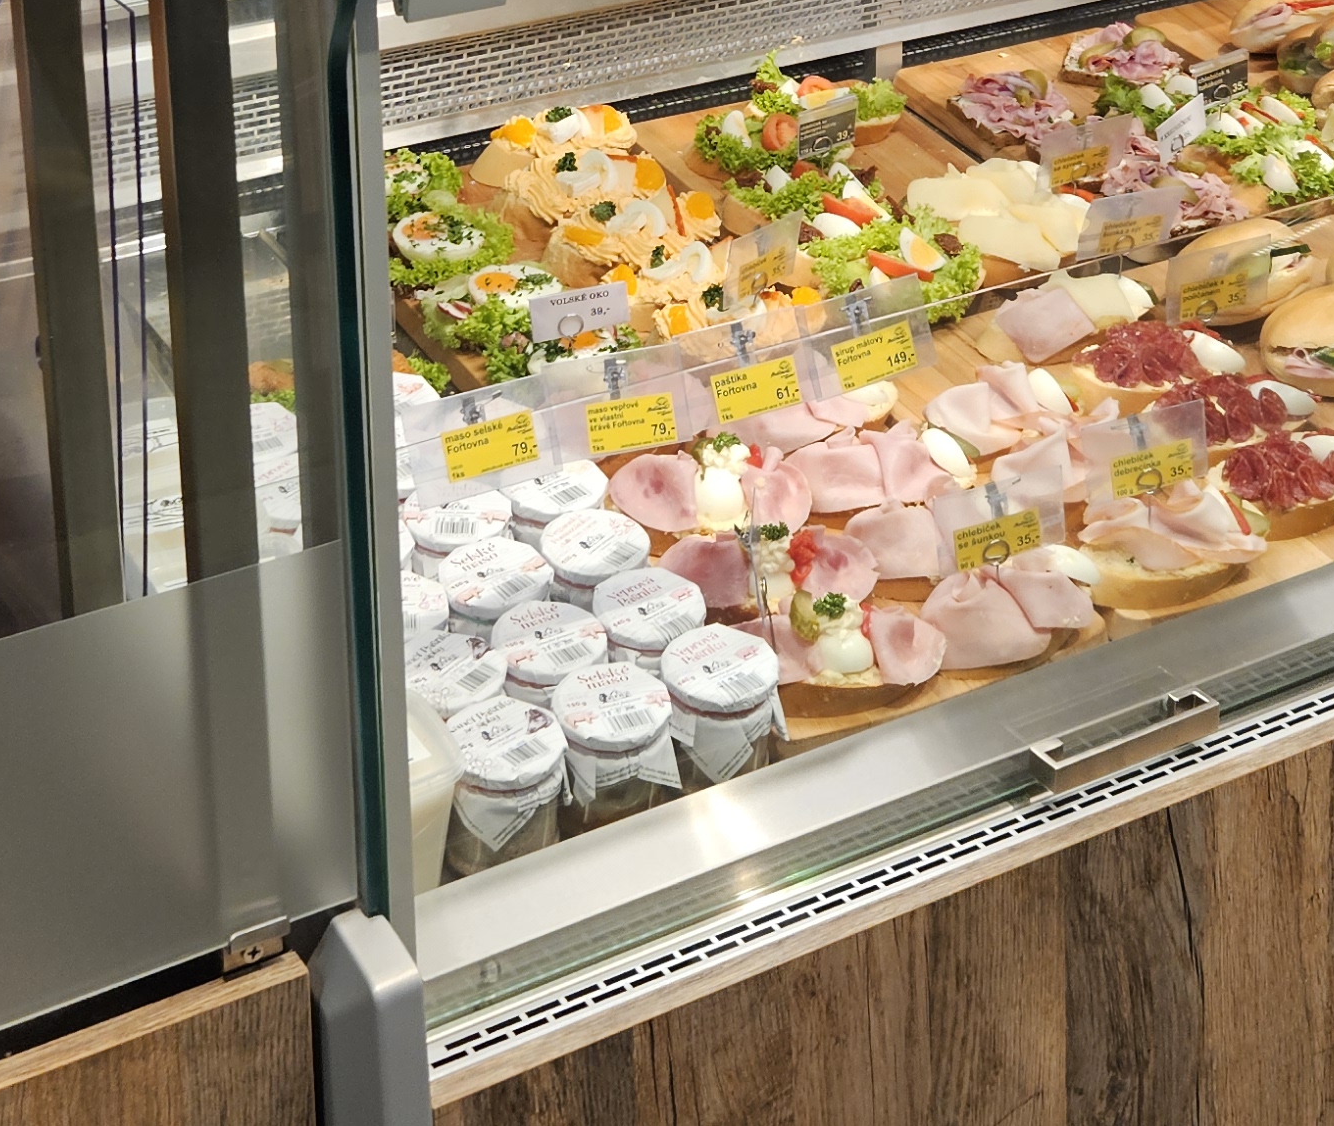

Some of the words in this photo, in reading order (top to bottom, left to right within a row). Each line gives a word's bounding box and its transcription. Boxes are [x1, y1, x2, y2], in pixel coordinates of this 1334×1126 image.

[550, 292, 587, 306] VOLSKÉ
[589, 290, 609, 300] OKO
[837, 349, 872, 367] Fořtovna
[886, 351, 915, 367] 149,-
[714, 373, 748, 390] paštika
[716, 382, 758, 399] Fořtovna
[776, 385, 800, 400] 61,-
[588, 406, 608, 416] maso
[445, 431, 471, 444] maso
[473, 421, 504, 437] selské
[651, 423, 675, 437] 79,-
[446, 437, 490, 455] Fořtovna
[511, 441, 538, 457] 79,-
[1113, 452, 1154, 469] chlebíček
[1169, 464, 1193, 478] 35,-
[956, 521, 1002, 541] chlebíček
[957, 541, 969, 551] se
[971, 531, 1006, 546] šunkou
[1016, 533, 1041, 547] 35,-
